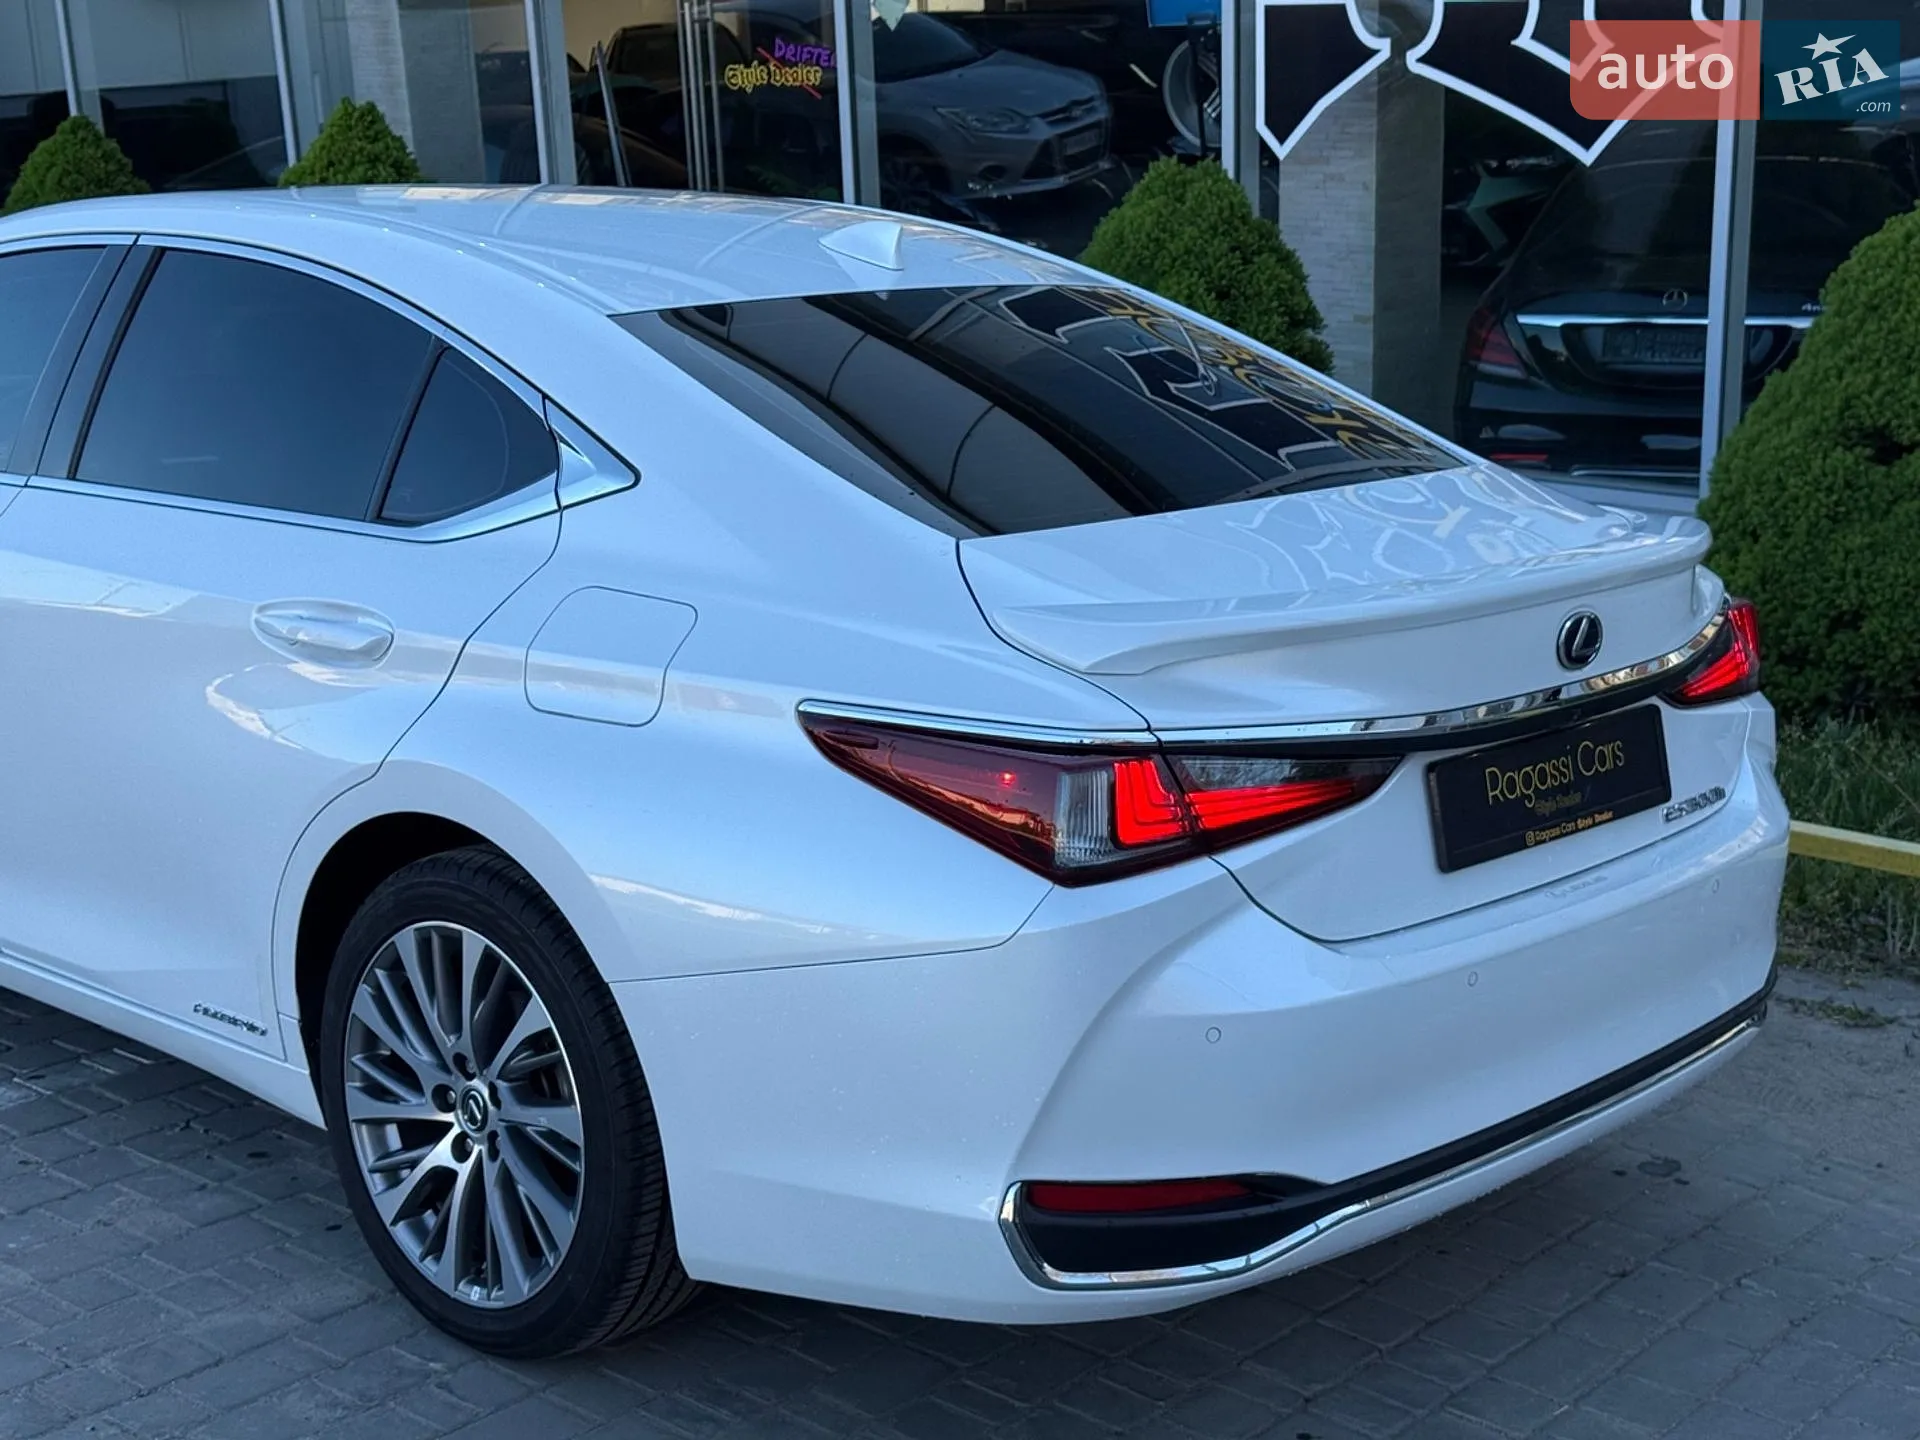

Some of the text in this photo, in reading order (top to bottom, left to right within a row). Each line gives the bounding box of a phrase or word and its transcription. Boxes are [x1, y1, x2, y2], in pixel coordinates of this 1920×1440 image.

[724, 60, 768, 93] Style
[1485, 745, 1574, 808] Ragassi
[1577, 740, 1625, 776] Cars
